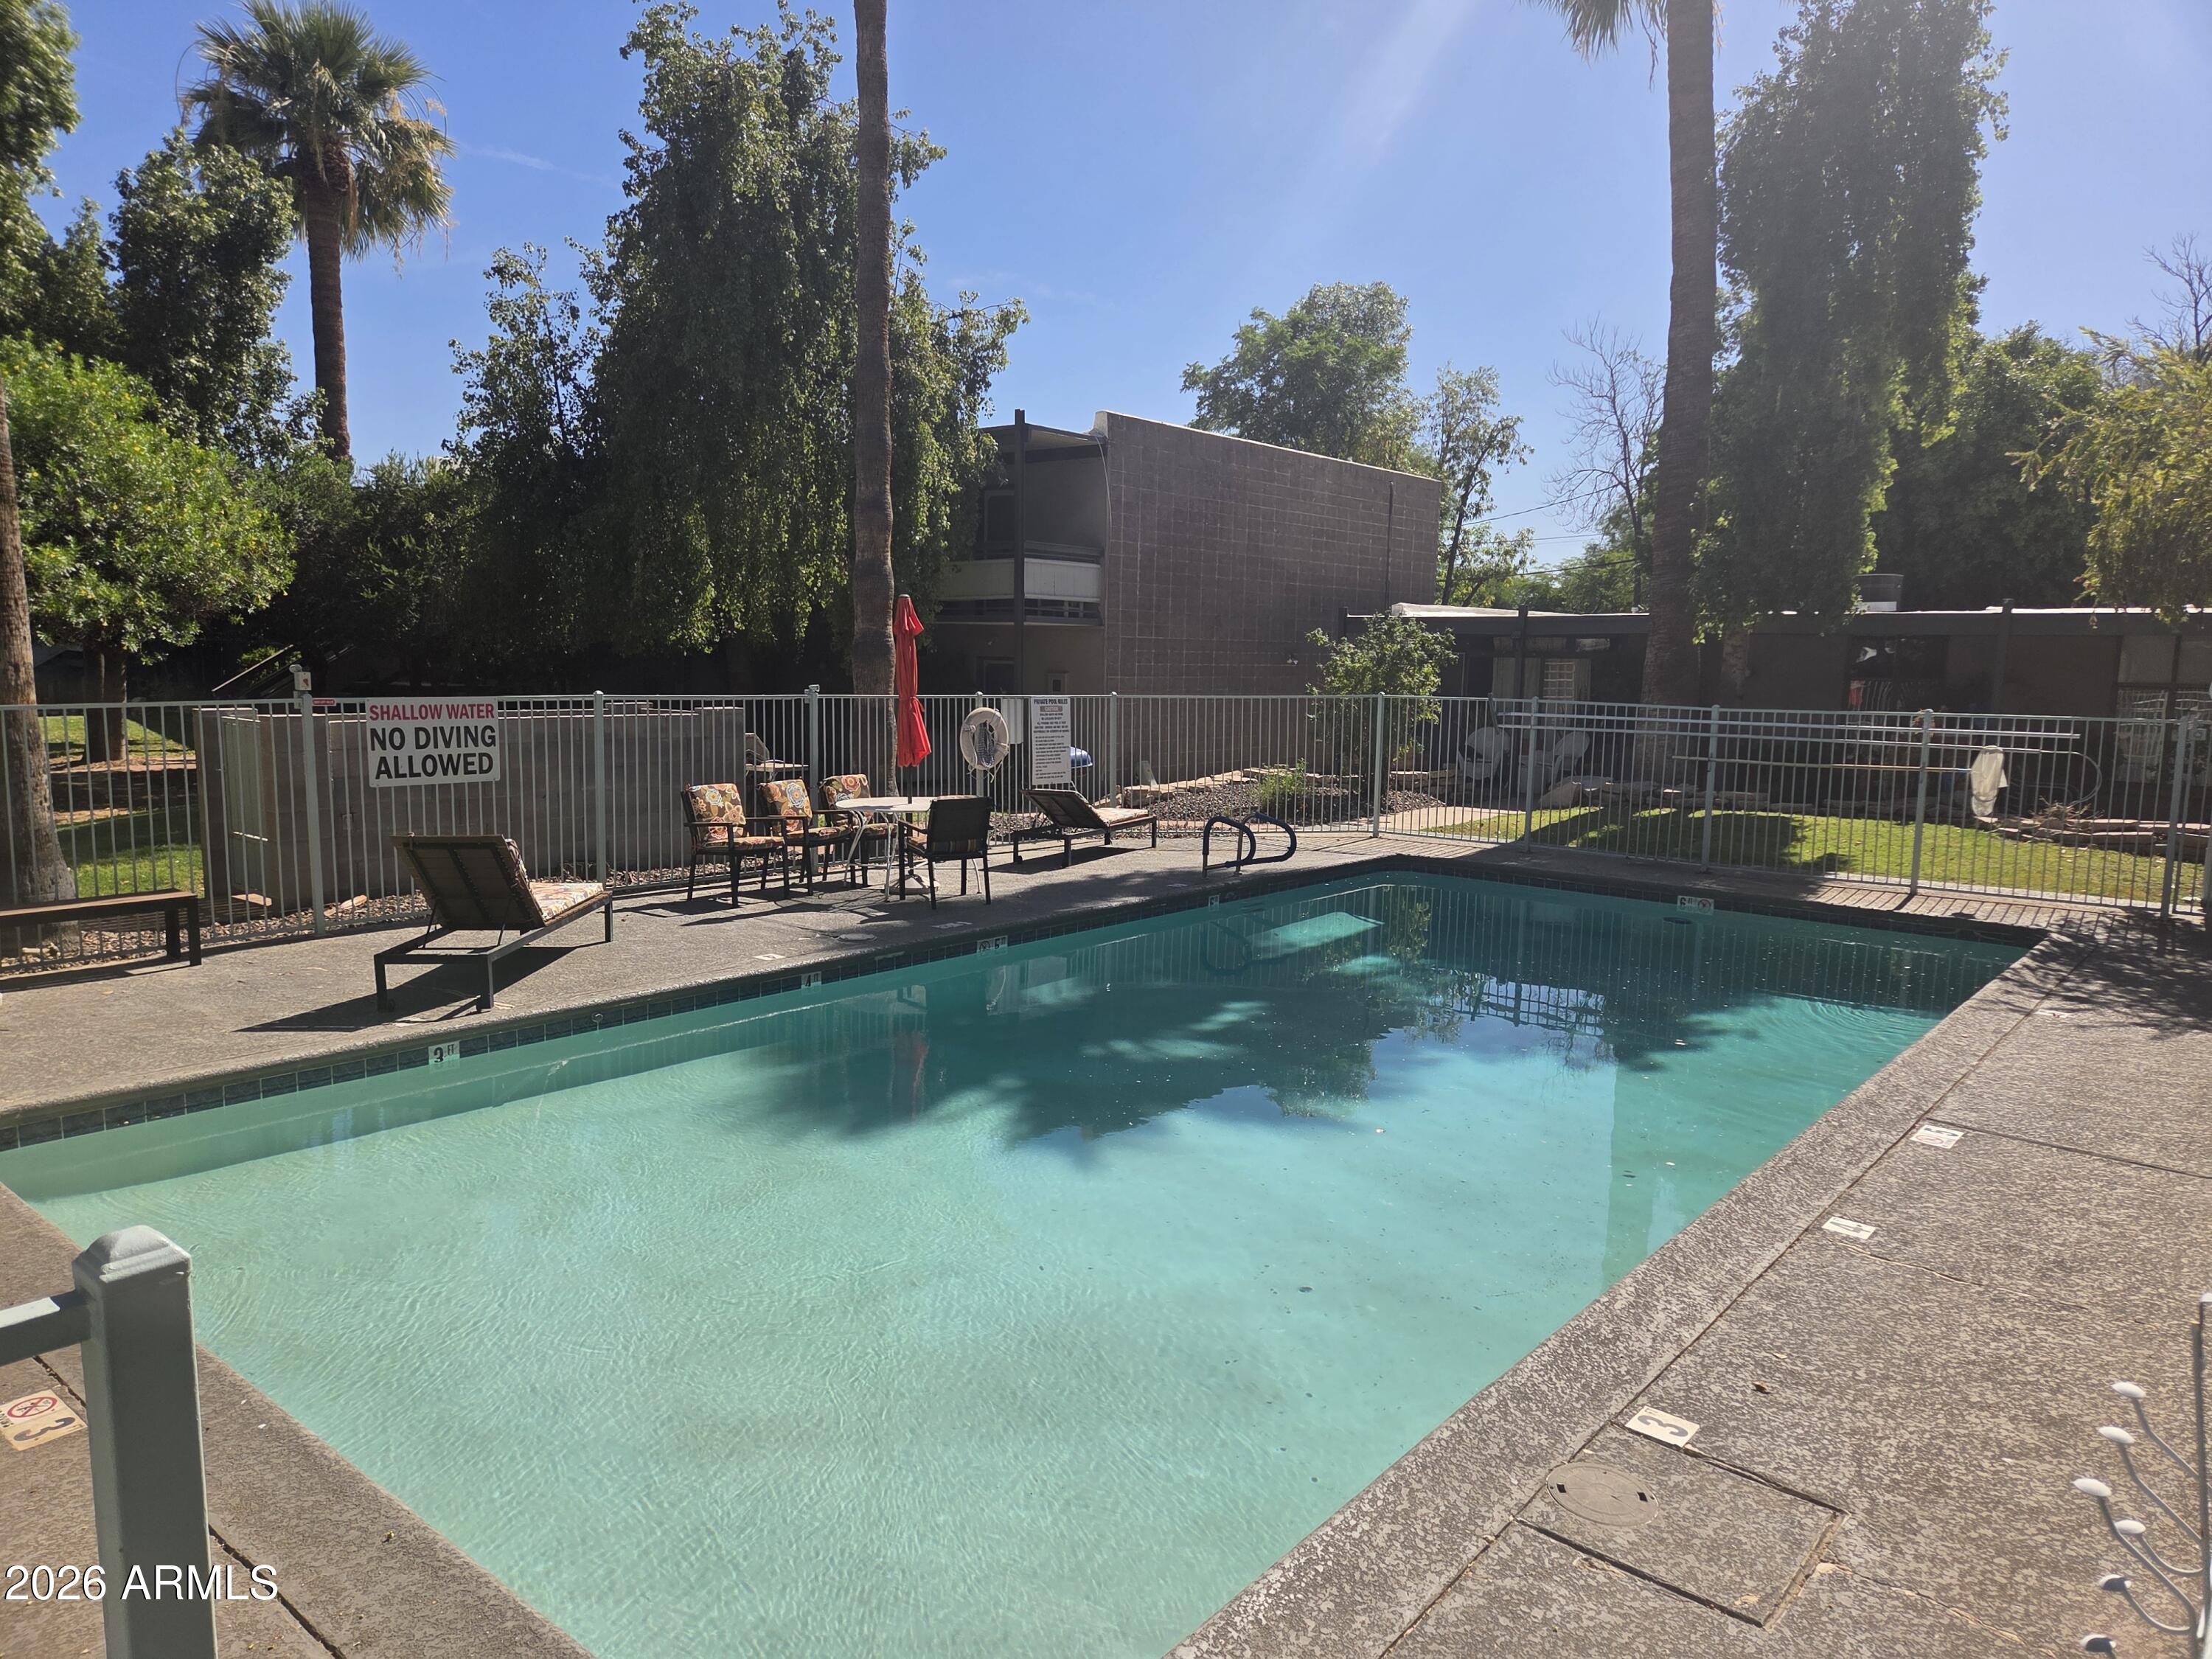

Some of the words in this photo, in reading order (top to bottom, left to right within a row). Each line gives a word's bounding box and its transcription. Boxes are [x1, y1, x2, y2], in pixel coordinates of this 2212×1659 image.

[369, 704, 442, 721] SHALLOW
[446, 703, 495, 720] WATER
[370, 727, 406, 751] NO
[414, 725, 495, 749] DIVING
[375, 752, 493, 779] ALLOWED
[434, 1047, 444, 1062] 3
[1829, 1221, 1871, 1234] 4
[13, 1417, 76, 1441] 3
[1638, 1415, 1688, 1437] 3
